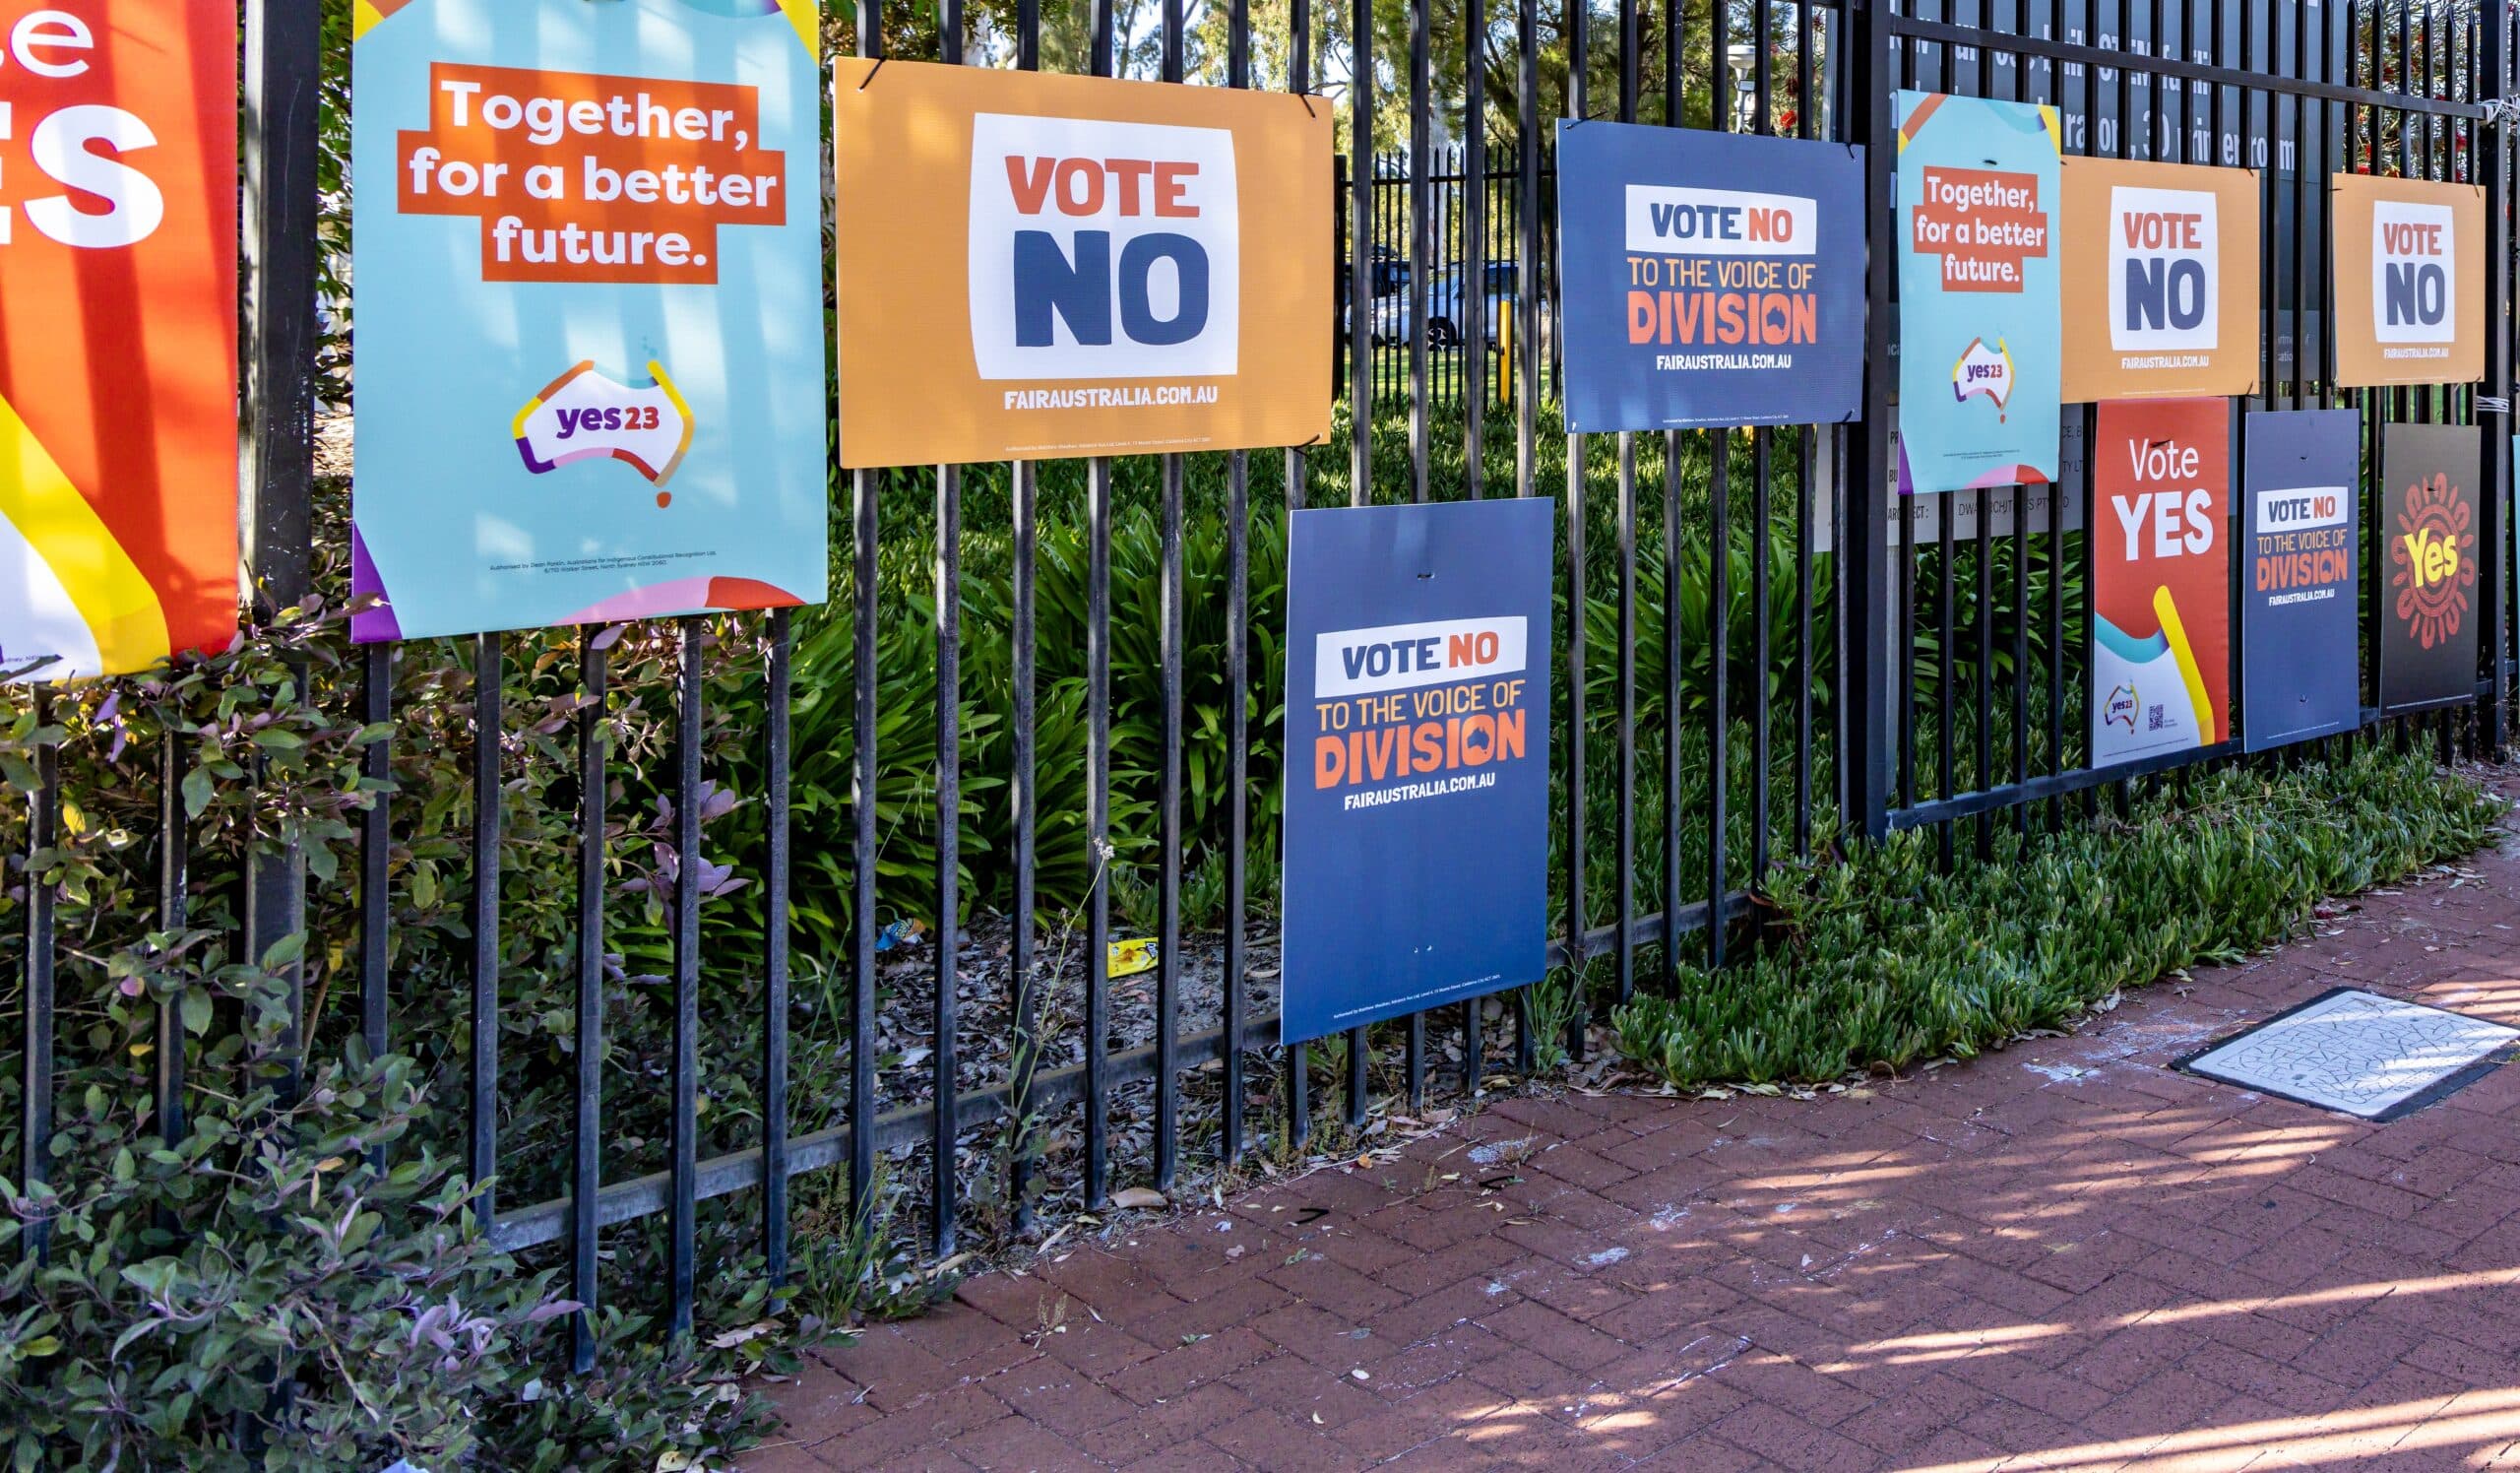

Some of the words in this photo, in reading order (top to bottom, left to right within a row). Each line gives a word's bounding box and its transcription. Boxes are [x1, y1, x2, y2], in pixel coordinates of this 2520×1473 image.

[442, 81, 749, 151] Together,
[410, 148, 509, 197] for
[525, 160, 572, 199] a
[584, 158, 777, 207] better
[1005, 156, 1199, 218] VOTE
[1926, 175, 2035, 213] Together,
[1650, 203, 1741, 239] VOTE
[1748, 208, 1793, 242] NO
[1917, 215, 1950, 242] for
[1956, 223, 1970, 244] a
[1976, 218, 2045, 246] better
[2123, 212, 2202, 249] VOTE
[2383, 223, 2442, 255] VOTE
[492, 218, 707, 267] future.
[1627, 257, 1659, 286] TO
[1665, 259, 1711, 287] THE
[1717, 261, 1782, 289] VOICE
[1788, 263, 1816, 289] OF
[1945, 253, 2020, 282] future.
[1014, 229, 1209, 347] NO
[2126, 258, 2205, 331] NO
[2386, 262, 2445, 326] NO
[1627, 290, 1816, 345] DIVISION
[1657, 354, 1792, 371] FAIRAUSTRALIA.COM.AU
[1967, 363, 2003, 382] yes23
[2121, 355, 2209, 369] FAIRAUSTRALIA.COM.AU
[1004, 386, 1218, 410] FAIRAUSTRALIA.COM.AU
[556, 405, 661, 440] yes23
[2129, 438, 2199, 481] Vote
[2110, 488, 2214, 561] YES
[2268, 497, 2310, 523] VOTE
[2313, 495, 2336, 519] NO
[2256, 537, 2272, 554] TO
[2274, 534, 2297, 553] THE
[2299, 530, 2331, 550] VOICE
[2333, 528, 2347, 546] OF
[2404, 527, 2458, 588] Yes
[2256, 548, 2348, 592] DIVISION
[2269, 589, 2335, 607] FAIRAUSTRALIA.COM.AU
[1343, 636, 1440, 679] VOTE
[1448, 631, 1499, 667] NO
[1315, 702, 1350, 731] TO
[1356, 694, 1407, 727] THE
[1414, 685, 1485, 720] VOICE
[1493, 679, 1526, 709] OF
[1315, 708, 1525, 790] DIVISION
[1345, 772, 1495, 811] FAIRAUSTRALIA.COM.AU
